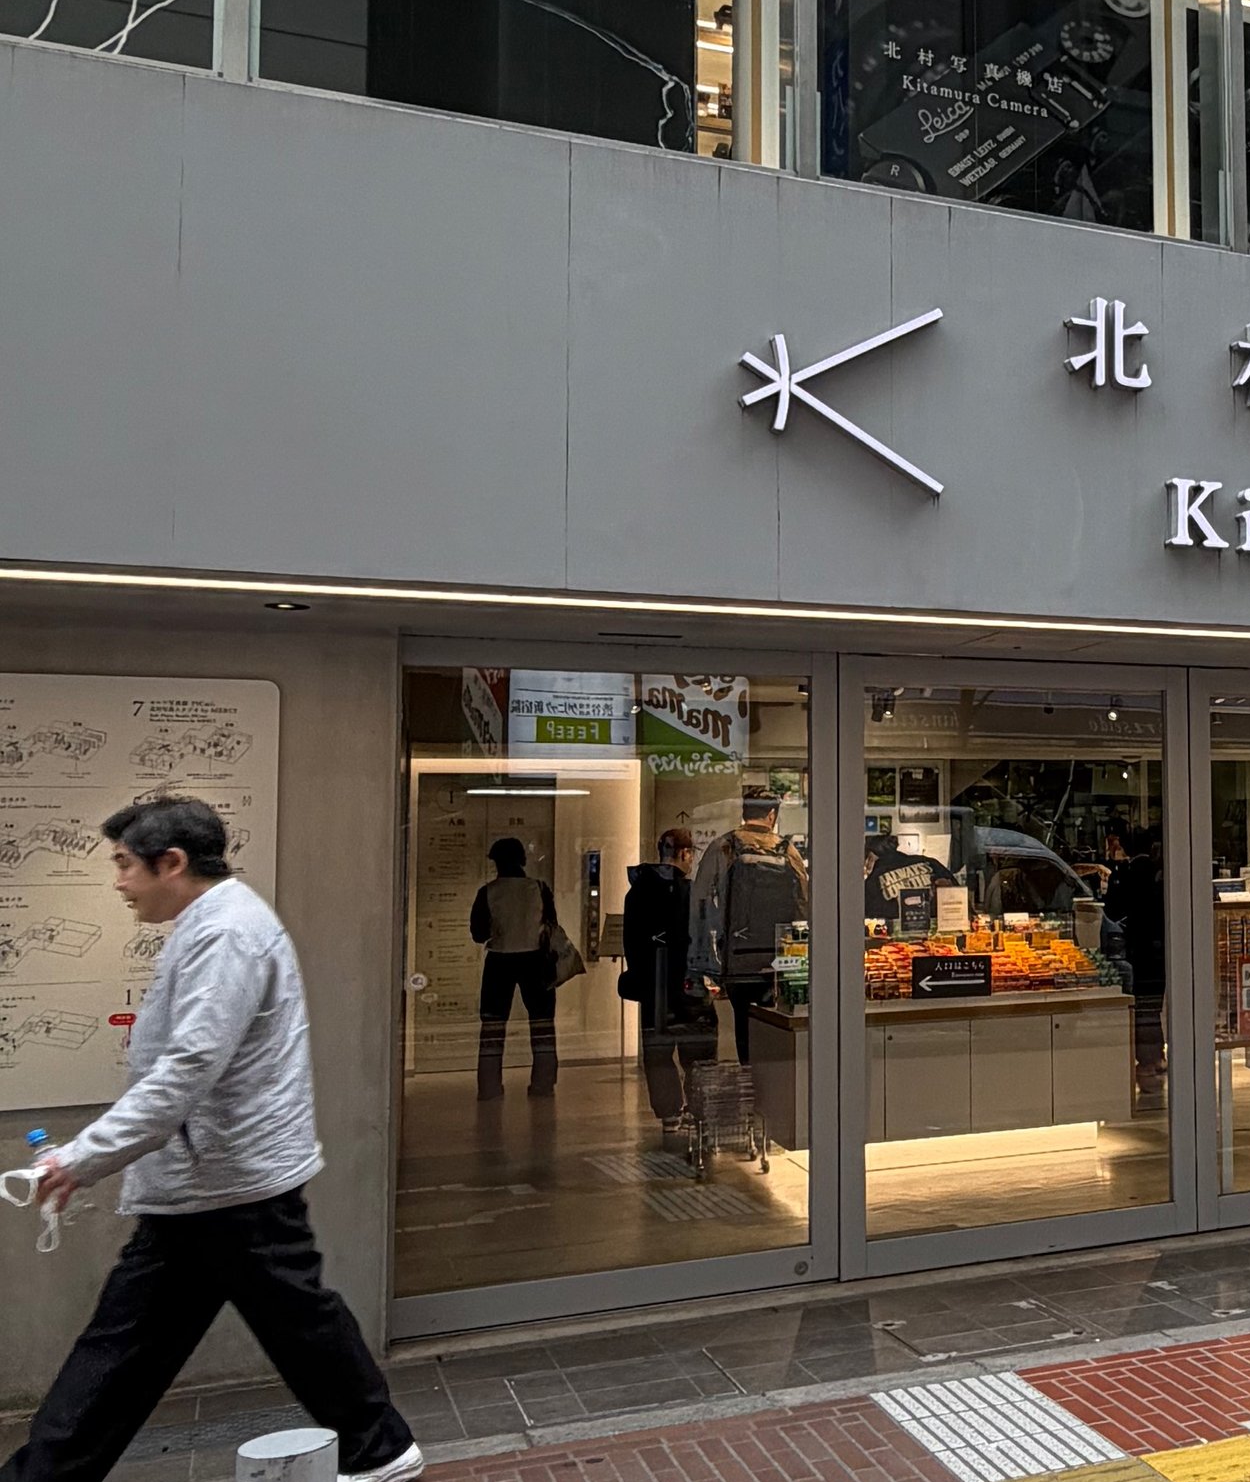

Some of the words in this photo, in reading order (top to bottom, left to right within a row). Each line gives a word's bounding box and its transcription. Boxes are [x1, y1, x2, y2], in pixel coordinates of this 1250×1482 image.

[884, 41, 1064, 94] 北村写真機店
[902, 74, 981, 105] Kitamura
[987, 92, 1048, 119] Camera
[918, 98, 975, 144] Leica
[948, 153, 976, 178] ERNST
[973, 138, 998, 166] LEITZ
[959, 158, 999, 188] WETZLAR
[999, 134, 1027, 159] GERMANY
[132, 700, 145, 717] 7
